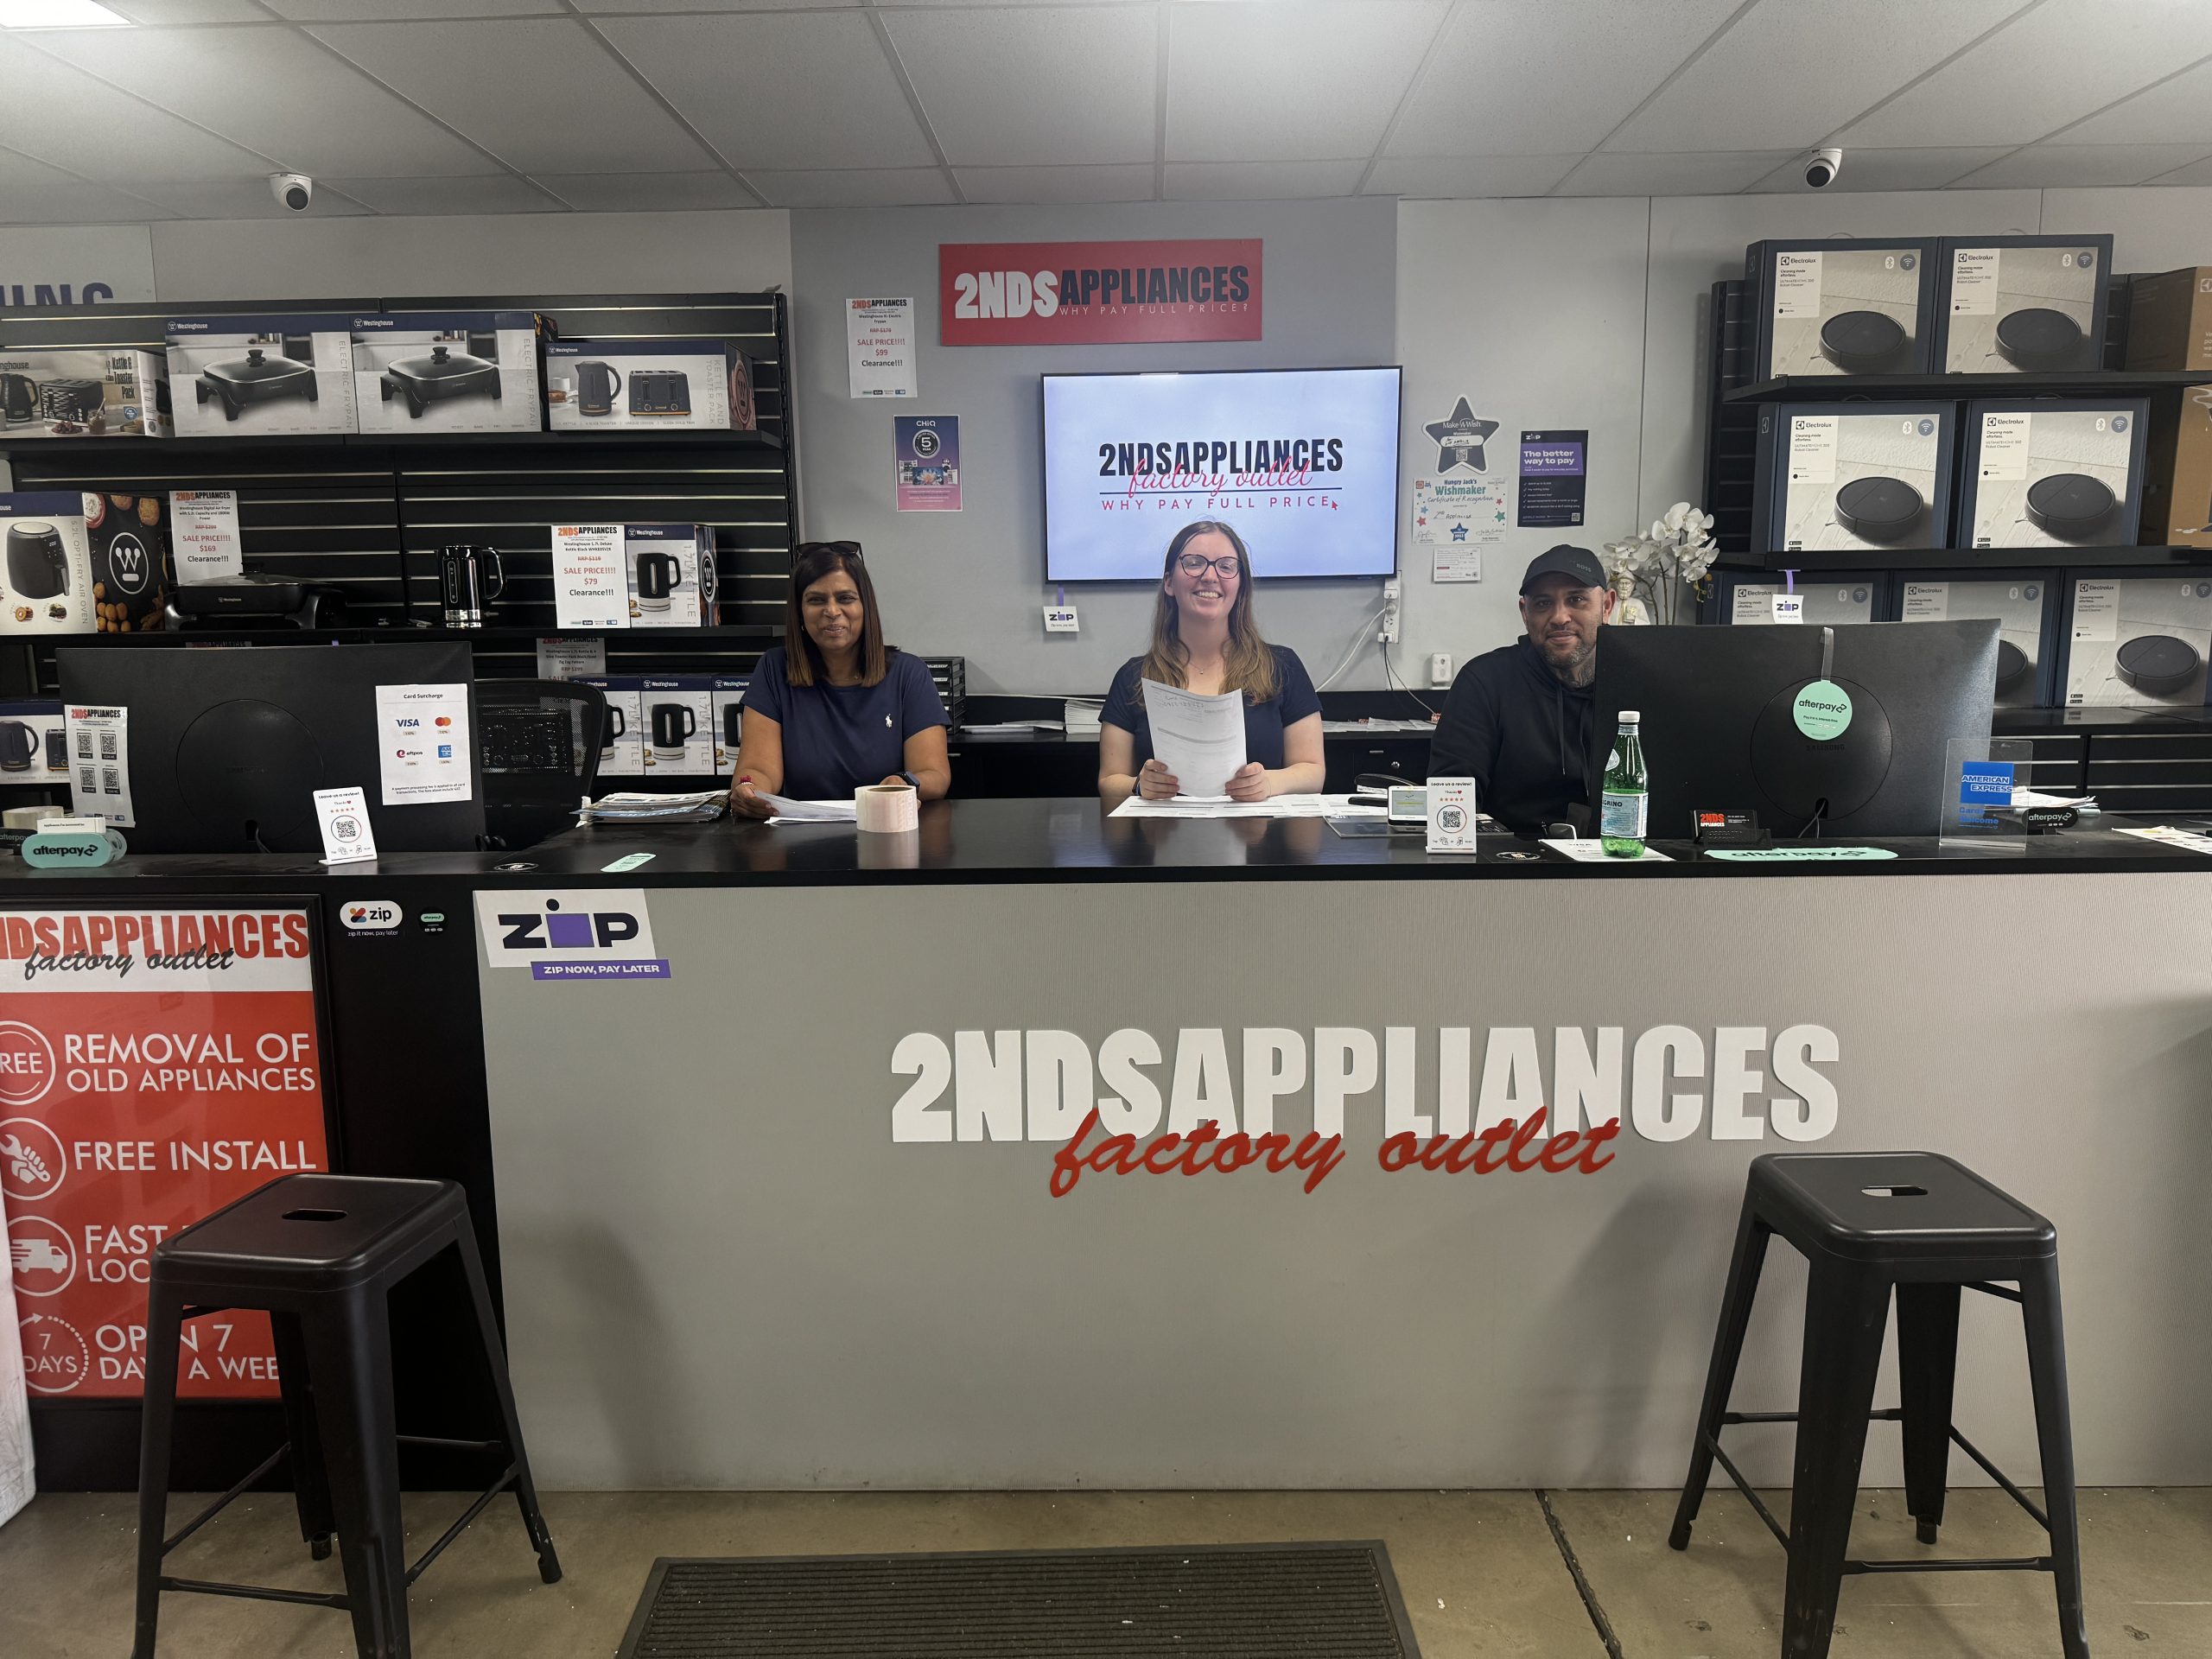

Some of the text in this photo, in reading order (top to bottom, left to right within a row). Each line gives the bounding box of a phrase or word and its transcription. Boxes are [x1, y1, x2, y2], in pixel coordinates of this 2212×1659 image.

[1060, 303, 1249, 315] WHY PAY FULL PRICE?
[0, 362, 29, 371] nghouse
[112, 357, 127, 369] Kettle
[339, 341, 349, 386] ELECTRIC
[524, 338, 533, 384] ELECTRIC
[114, 372, 133, 384] Toaster
[706, 361, 715, 399] TOASTER
[714, 360, 722, 400] KETTLE
[122, 386, 135, 399] Pack
[921, 437, 931, 447] 5
[1099, 438, 1343, 476] 2NDSAPPLIANCES
[1128, 455, 1313, 498] factory outlet
[1427, 495, 1494, 504] Certificate Recognition
[1435, 486, 1486, 495] Wishmaker
[1103, 496, 1329, 510] WHY PAY FULL PRICE
[1577, 563, 1591, 572] BOSS
[685, 571, 696, 617] KETTLE
[1799, 699, 1837, 712] afterpay
[629, 721, 640, 766] KETTLE
[700, 720, 709, 766] KETTLE
[1961, 775, 2009, 784] AMERICAN
[1700, 814, 1724, 822] 2NDS
[1959, 816, 1999, 824] Welcome
[2029, 813, 2062, 821] afterpay
[33, 846, 83, 856] afterpay
[370, 907, 392, 922] zip
[0, 914, 308, 959] DSAPPLIANCES
[24, 943, 234, 981] factory outlet
[544, 966, 563, 974] ZIP
[565, 965, 597, 975] NOW,
[621, 964, 660, 973] LATER
[65, 1033, 308, 1064] REMOVAL OF
[0, 1052, 43, 1074] REE
[67, 1068, 315, 1093] OLD APPLIANCES
[891, 1025, 1839, 1142] 2NDSAPPLIANCES
[73, 1141, 316, 1170] FREE INSTALL
[1049, 1106, 1620, 1198] factory outlet
[85, 1225, 168, 1254] FAST
[87, 1259, 149, 1282] LOC
[39, 1334, 51, 1350] 7
[95, 1324, 233, 1352] OPN 7
[22, 1357, 77, 1373] DAYS
[99, 1357, 279, 1380] DA A WEE
